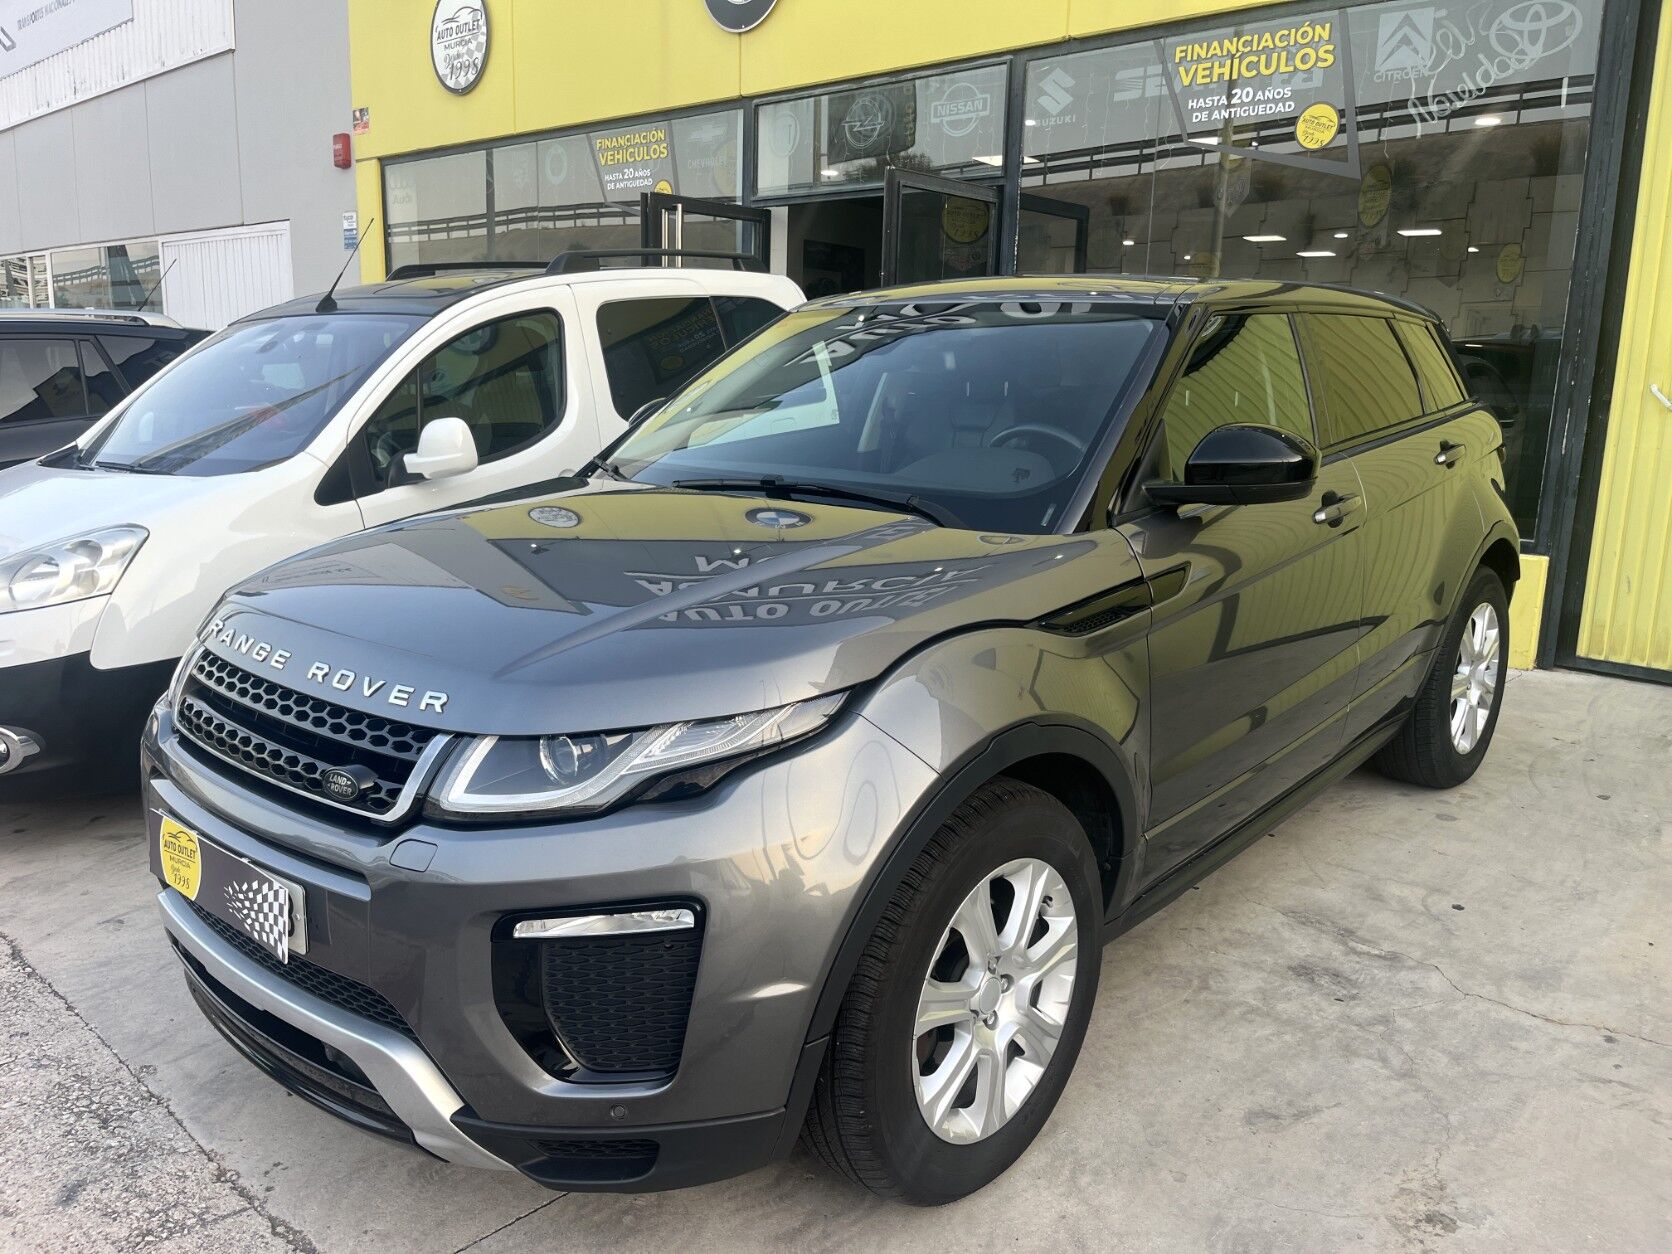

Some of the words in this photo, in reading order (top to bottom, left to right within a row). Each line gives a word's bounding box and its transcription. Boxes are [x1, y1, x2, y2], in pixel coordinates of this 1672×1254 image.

[437, 27, 453, 41] AUTO
[455, 19, 480, 35] OUTLET
[444, 38, 473, 51] MURCIA
[1174, 21, 1332, 63] FINANCIACIÓN
[450, 57, 479, 80] 1998
[1178, 44, 1335, 87] VEHÍCULOS
[937, 99, 983, 117] NISSAN
[1188, 95, 1227, 109] HASTA
[1231, 87, 1254, 104] 20
[1255, 87, 1292, 101] AÑOS
[1192, 111, 1208, 123] DE
[1211, 101, 1295, 120] ANTIGUEDAD
[596, 128, 665, 150] FINANCIACIÓN
[599, 143, 668, 166] VEHÍCULOS
[604, 172, 622, 182] HASTA
[624, 168, 634, 179] 20
[634, 168, 651, 178] AÑOS
[607, 182, 615, 190] DE
[616, 178, 653, 189] ANTIGUEDAD
[207, 619, 292, 670] RANGE
[306, 660, 449, 714] ROVER
[164, 839, 177, 852] AUTO
[178, 844, 196, 860] OUTLET
[169, 855, 191, 869] MURCIA
